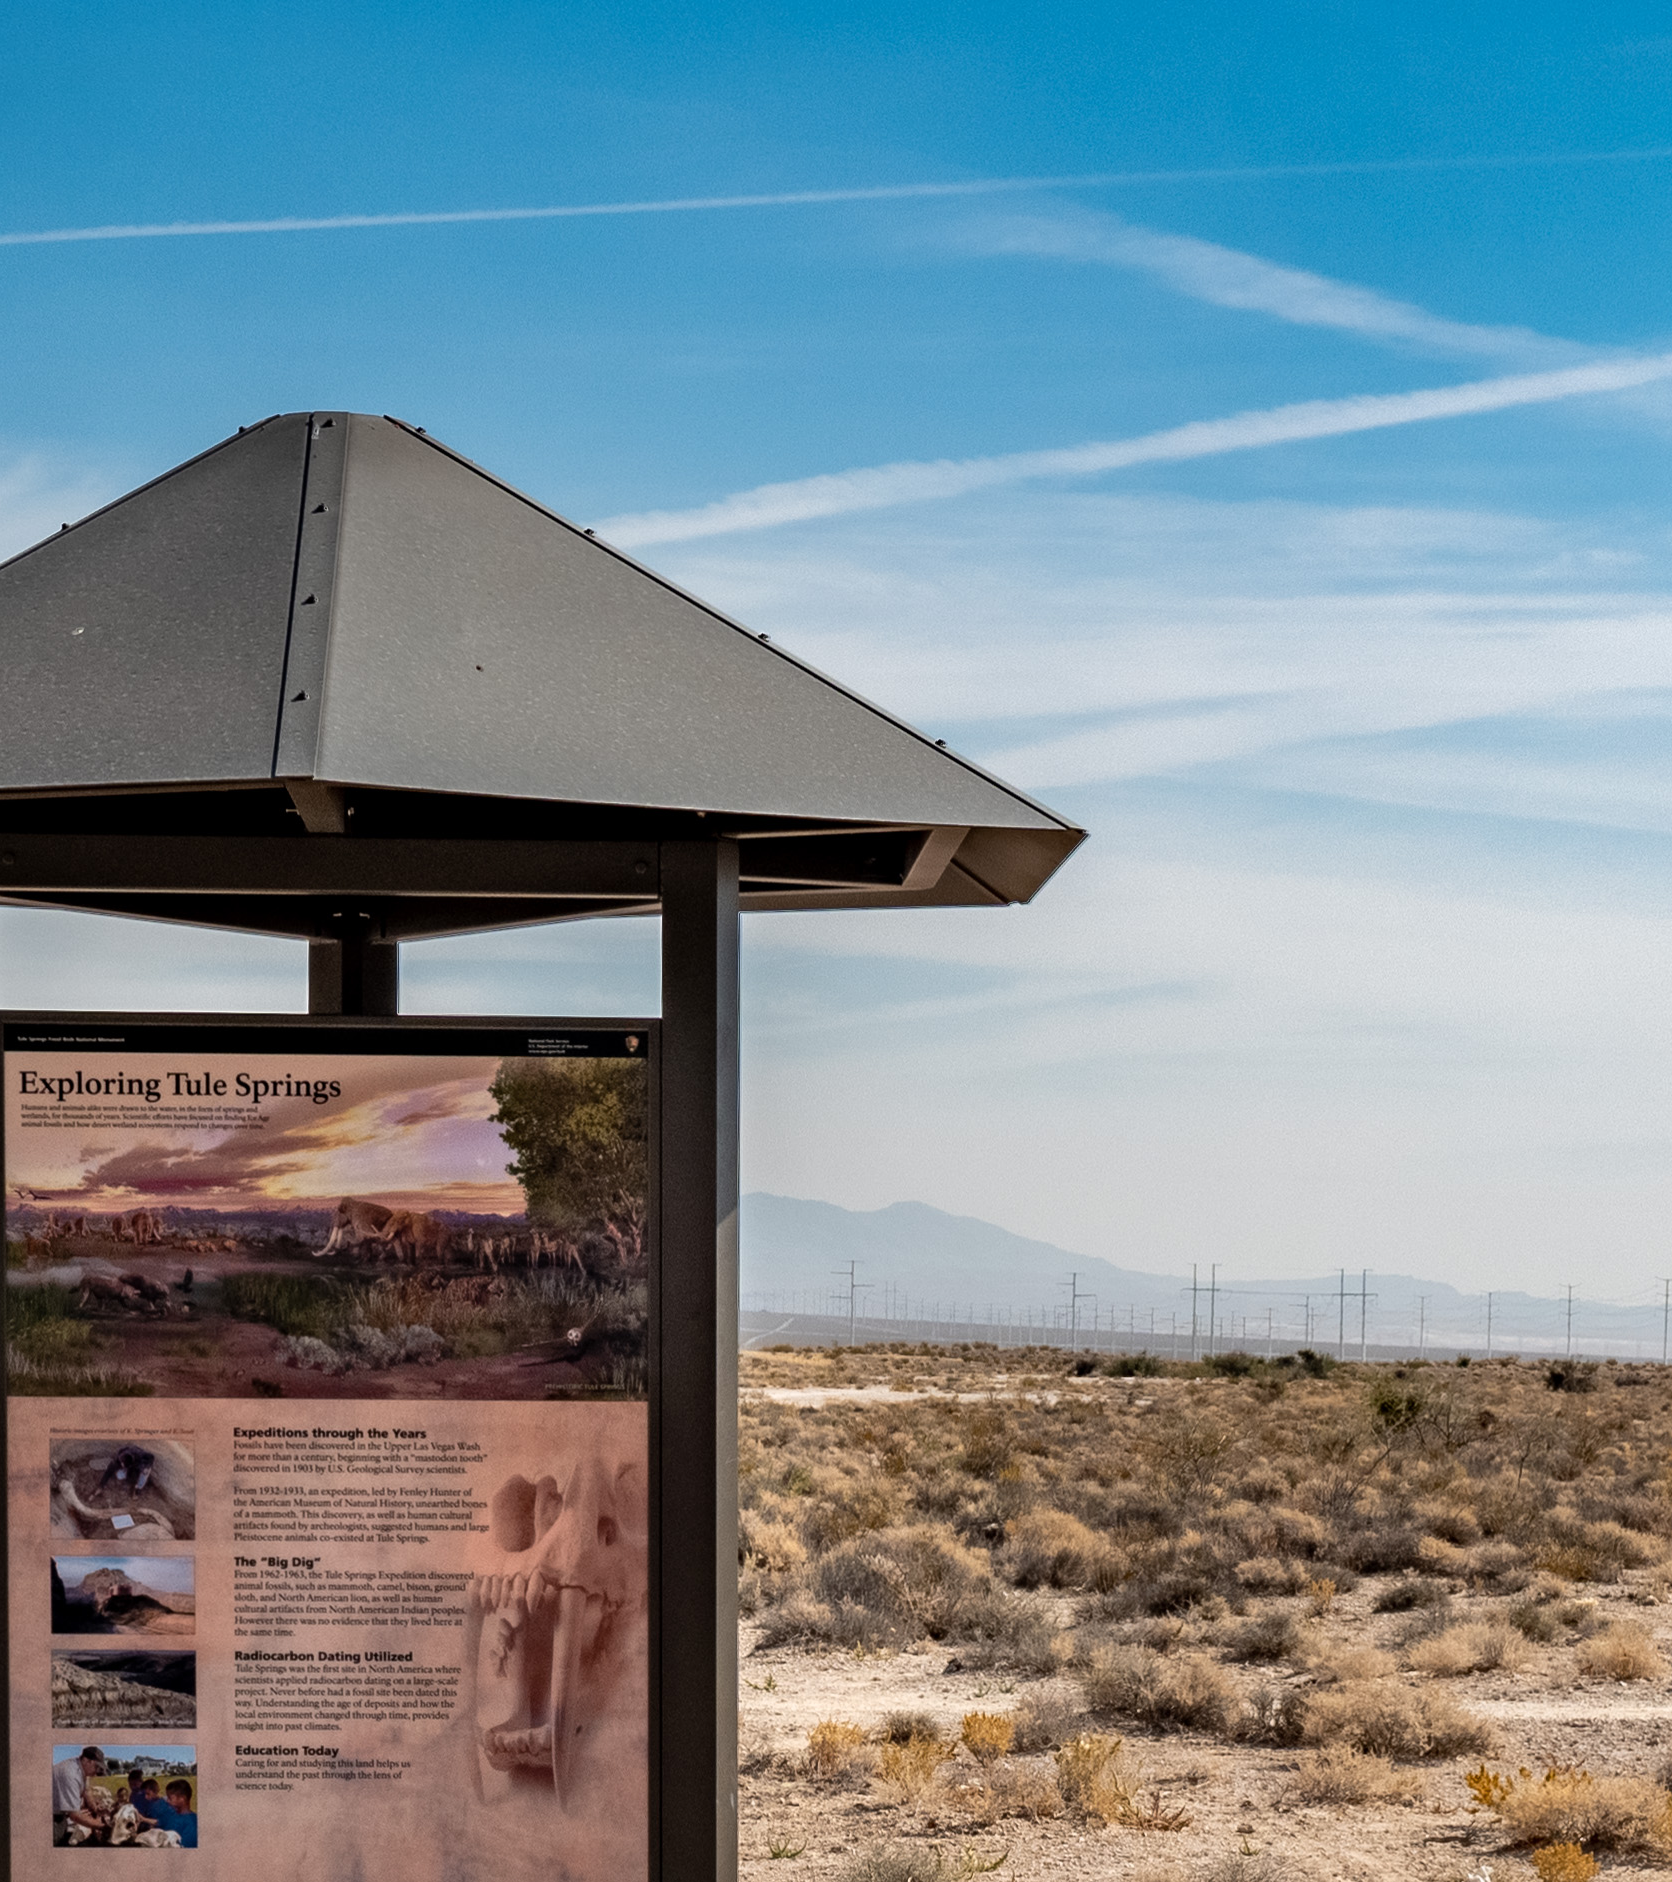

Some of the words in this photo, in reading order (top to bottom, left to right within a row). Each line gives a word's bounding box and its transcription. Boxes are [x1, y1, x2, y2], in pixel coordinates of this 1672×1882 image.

[19, 1070, 161, 1102] Exploring
[167, 1072, 227, 1096] Tule
[235, 1072, 341, 1104] Springs
[233, 1428, 309, 1440] Expeditions
[311, 1428, 364, 1441] through
[366, 1428, 389, 1438] the
[392, 1429, 427, 1439] Years
[233, 1440, 262, 1449] Fossils
[263, 1440, 284, 1449] have
[285, 1440, 307, 1449] been
[308, 1440, 356, 1449] discovered
[357, 1440, 366, 1450] in
[367, 1441, 382, 1450] the
[383, 1441, 412, 1452] Upper
[413, 1441, 429, 1450] Las
[430, 1441, 456, 1453] Vegas
[457, 1441, 480, 1450] Wash
[233, 1451, 246, 1461] for
[272, 1452, 292, 1461] than
[300, 1453, 336, 1464] century,
[337, 1452, 381, 1464] beginning
[382, 1453, 402, 1462] with
[233, 1463, 280, 1472] discovered
[281, 1463, 292, 1472] in
[293, 1463, 313, 1473] 1903
[314, 1464, 326, 1475] by
[327, 1464, 345, 1473] U.S.
[346, 1464, 393, 1476] Geological
[394, 1464, 424, 1476] Survey
[425, 1465, 467, 1474] scientists.
[233, 1485, 258, 1495] From
[320, 1486, 370, 1498] expedition,
[371, 1487, 385, 1496] led
[386, 1487, 398, 1498] by
[399, 1487, 428, 1499] Fenley
[429, 1487, 461, 1496] Hunter
[462, 1487, 473, 1496] of
[234, 1497, 248, 1506] the
[248, 1497, 292, 1506] American
[293, 1498, 332, 1507] Museum
[333, 1498, 343, 1507] of
[344, 1498, 378, 1507] Natural
[379, 1498, 414, 1510] History,
[415, 1499, 460, 1508] unearthed
[461, 1499, 487, 1508] bones
[234, 1508, 244, 1518] of
[251, 1509, 300, 1518] mammoth.
[301, 1509, 320, 1518] This
[321, 1509, 364, 1521] discovery,
[376, 1510, 395, 1519] well
[407, 1510, 438, 1519] human
[439, 1510, 473, 1519] cultural
[234, 1520, 269, 1529] artifacts
[270, 1521, 296, 1530] found
[297, 1521, 309, 1532] by
[309, 1521, 369, 1533] archeologists,
[370, 1521, 413, 1533] suggested
[414, 1522, 449, 1531] humans
[450, 1522, 467, 1531] and
[468, 1522, 490, 1534] large
[234, 1532, 283, 1541] Pleistocene
[284, 1532, 318, 1541] animals
[319, 1533, 364, 1542] co-existed
[365, 1534, 374, 1542] at
[375, 1533, 395, 1542] Tule
[396, 1533, 430, 1545] Springs.
[234, 1557, 258, 1567] The
[234, 1569, 259, 1578] From
[260, 1569, 307, 1580] 1962-1963,
[308, 1570, 323, 1579] the
[324, 1570, 343, 1579] Tule
[344, 1570, 377, 1582] Springs
[378, 1570, 426, 1582] Expedition
[427, 1571, 474, 1580] discovered
[234, 1580, 263, 1589] animal
[264, 1581, 294, 1591] fossils,
[295, 1581, 315, 1590] such
[327, 1581, 375, 1591] mammoth,
[376, 1581, 405, 1592] camel,
[406, 1582, 433, 1592] bison,
[434, 1582, 466, 1594] ground
[234, 1651, 315, 1661] Radiocarbon
[317, 1651, 361, 1664] Dating
[364, 1652, 413, 1662] Utilized
[236, 1663, 253, 1672] Tule
[254, 1663, 287, 1675] Springs
[306, 1663, 321, 1672] the
[322, 1663, 340, 1673] first
[341, 1664, 356, 1673] site
[357, 1664, 367, 1673] in
[368, 1664, 395, 1673] North
[396, 1664, 433, 1673] America
[434, 1664, 461, 1673] where
[235, 1745, 299, 1755] Education
[302, 1746, 339, 1758] Today
[235, 1758, 265, 1769] Caring
[266, 1758, 279, 1767] for
[280, 1758, 297, 1767] and
[298, 1758, 336, 1770] studying
[337, 1758, 354, 1767] this
[355, 1758, 374, 1768] land
[375, 1759, 399, 1770] helps
[235, 1781, 267, 1790] science
[268, 1781, 294, 1793] today.
